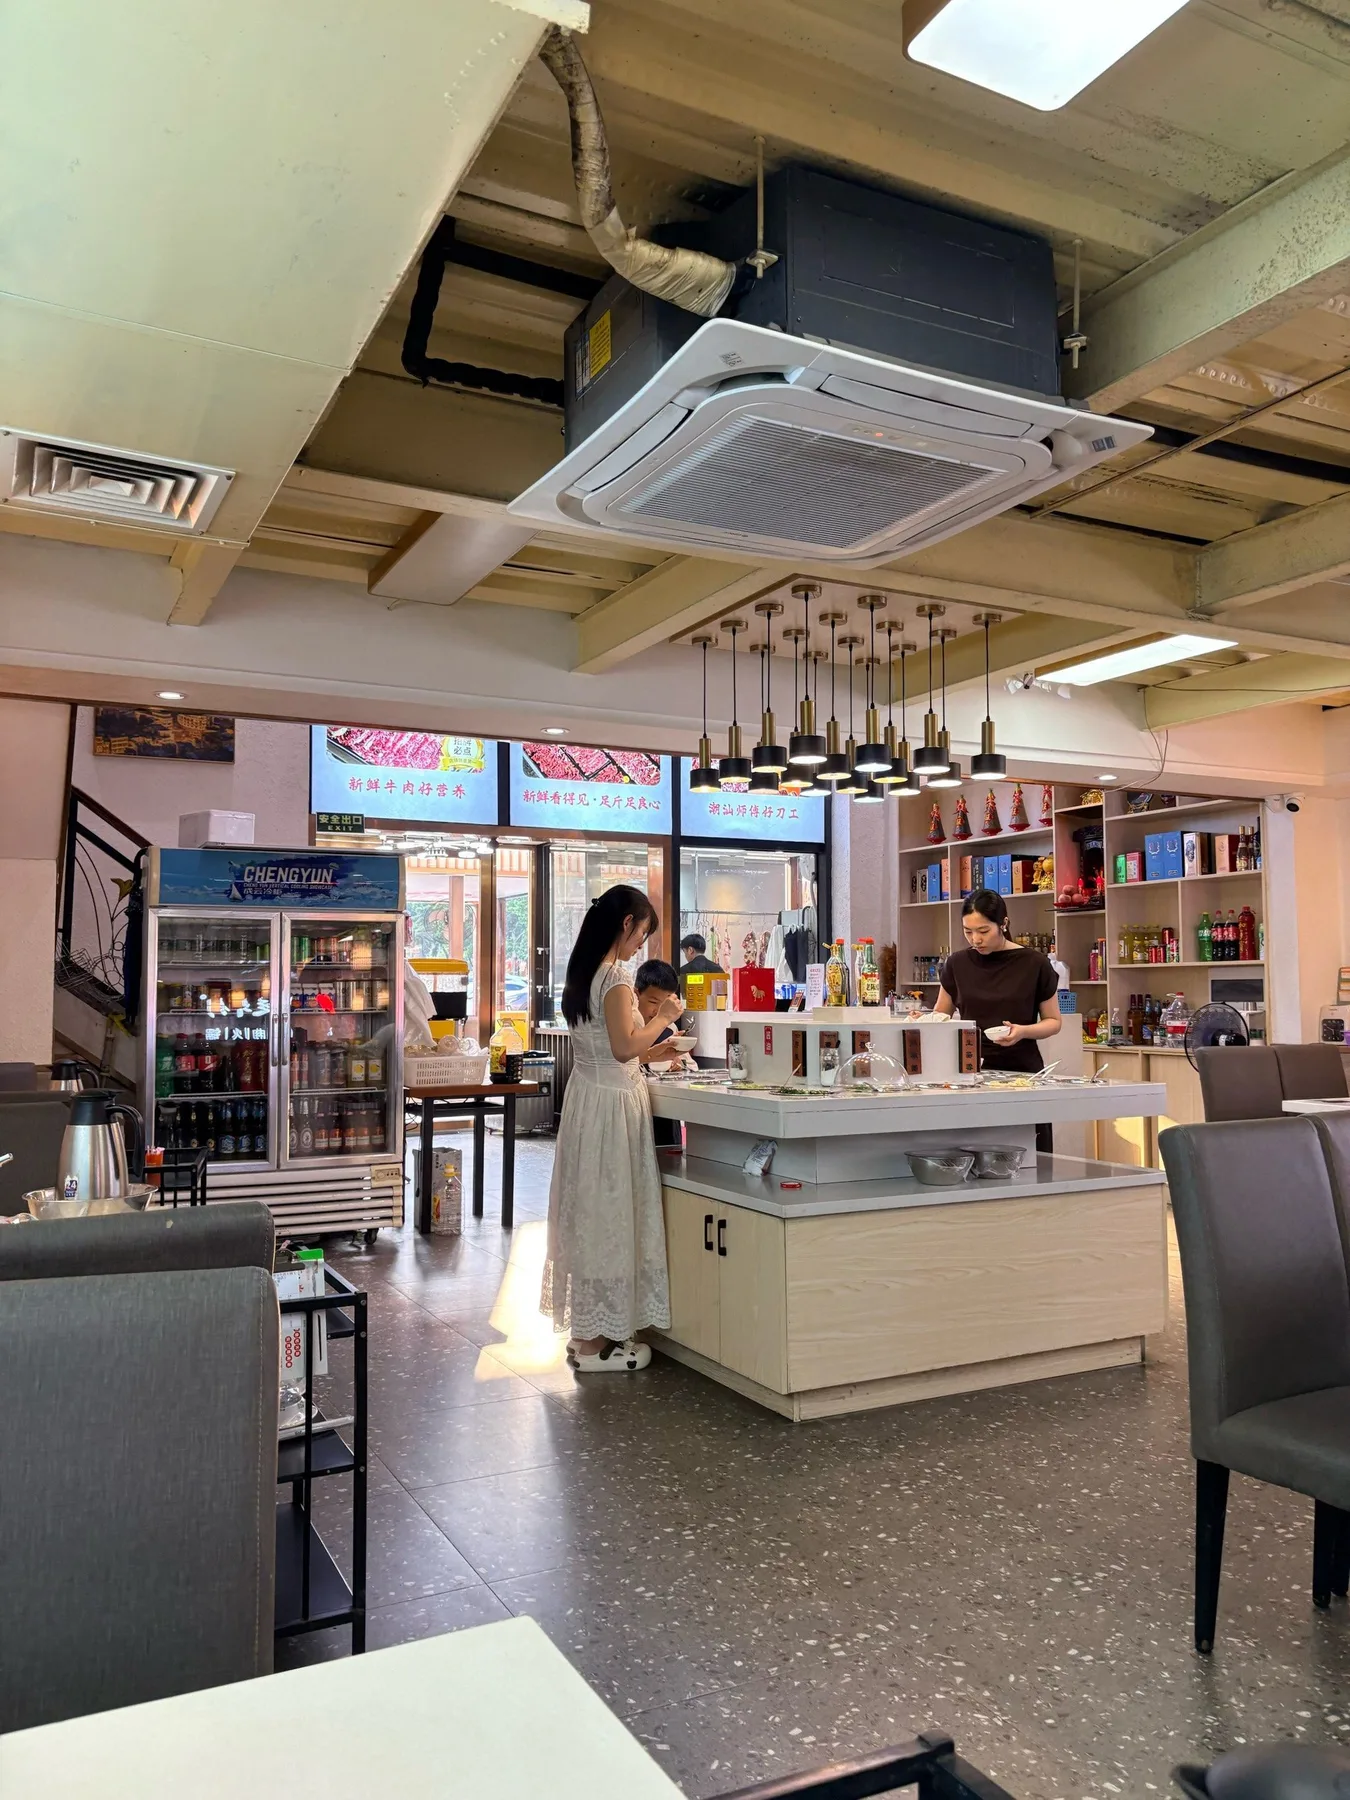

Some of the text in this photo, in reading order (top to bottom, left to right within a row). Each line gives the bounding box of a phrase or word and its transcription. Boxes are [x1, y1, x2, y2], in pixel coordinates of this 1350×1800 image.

[453, 746, 472, 756] 必点
[348, 776, 466, 799] 新鲜牛肉好营养
[708, 801, 799, 819] 潮汕师傅好刀工
[318, 814, 362, 825] 安全出口
[243, 866, 334, 884] CHENGYUN
